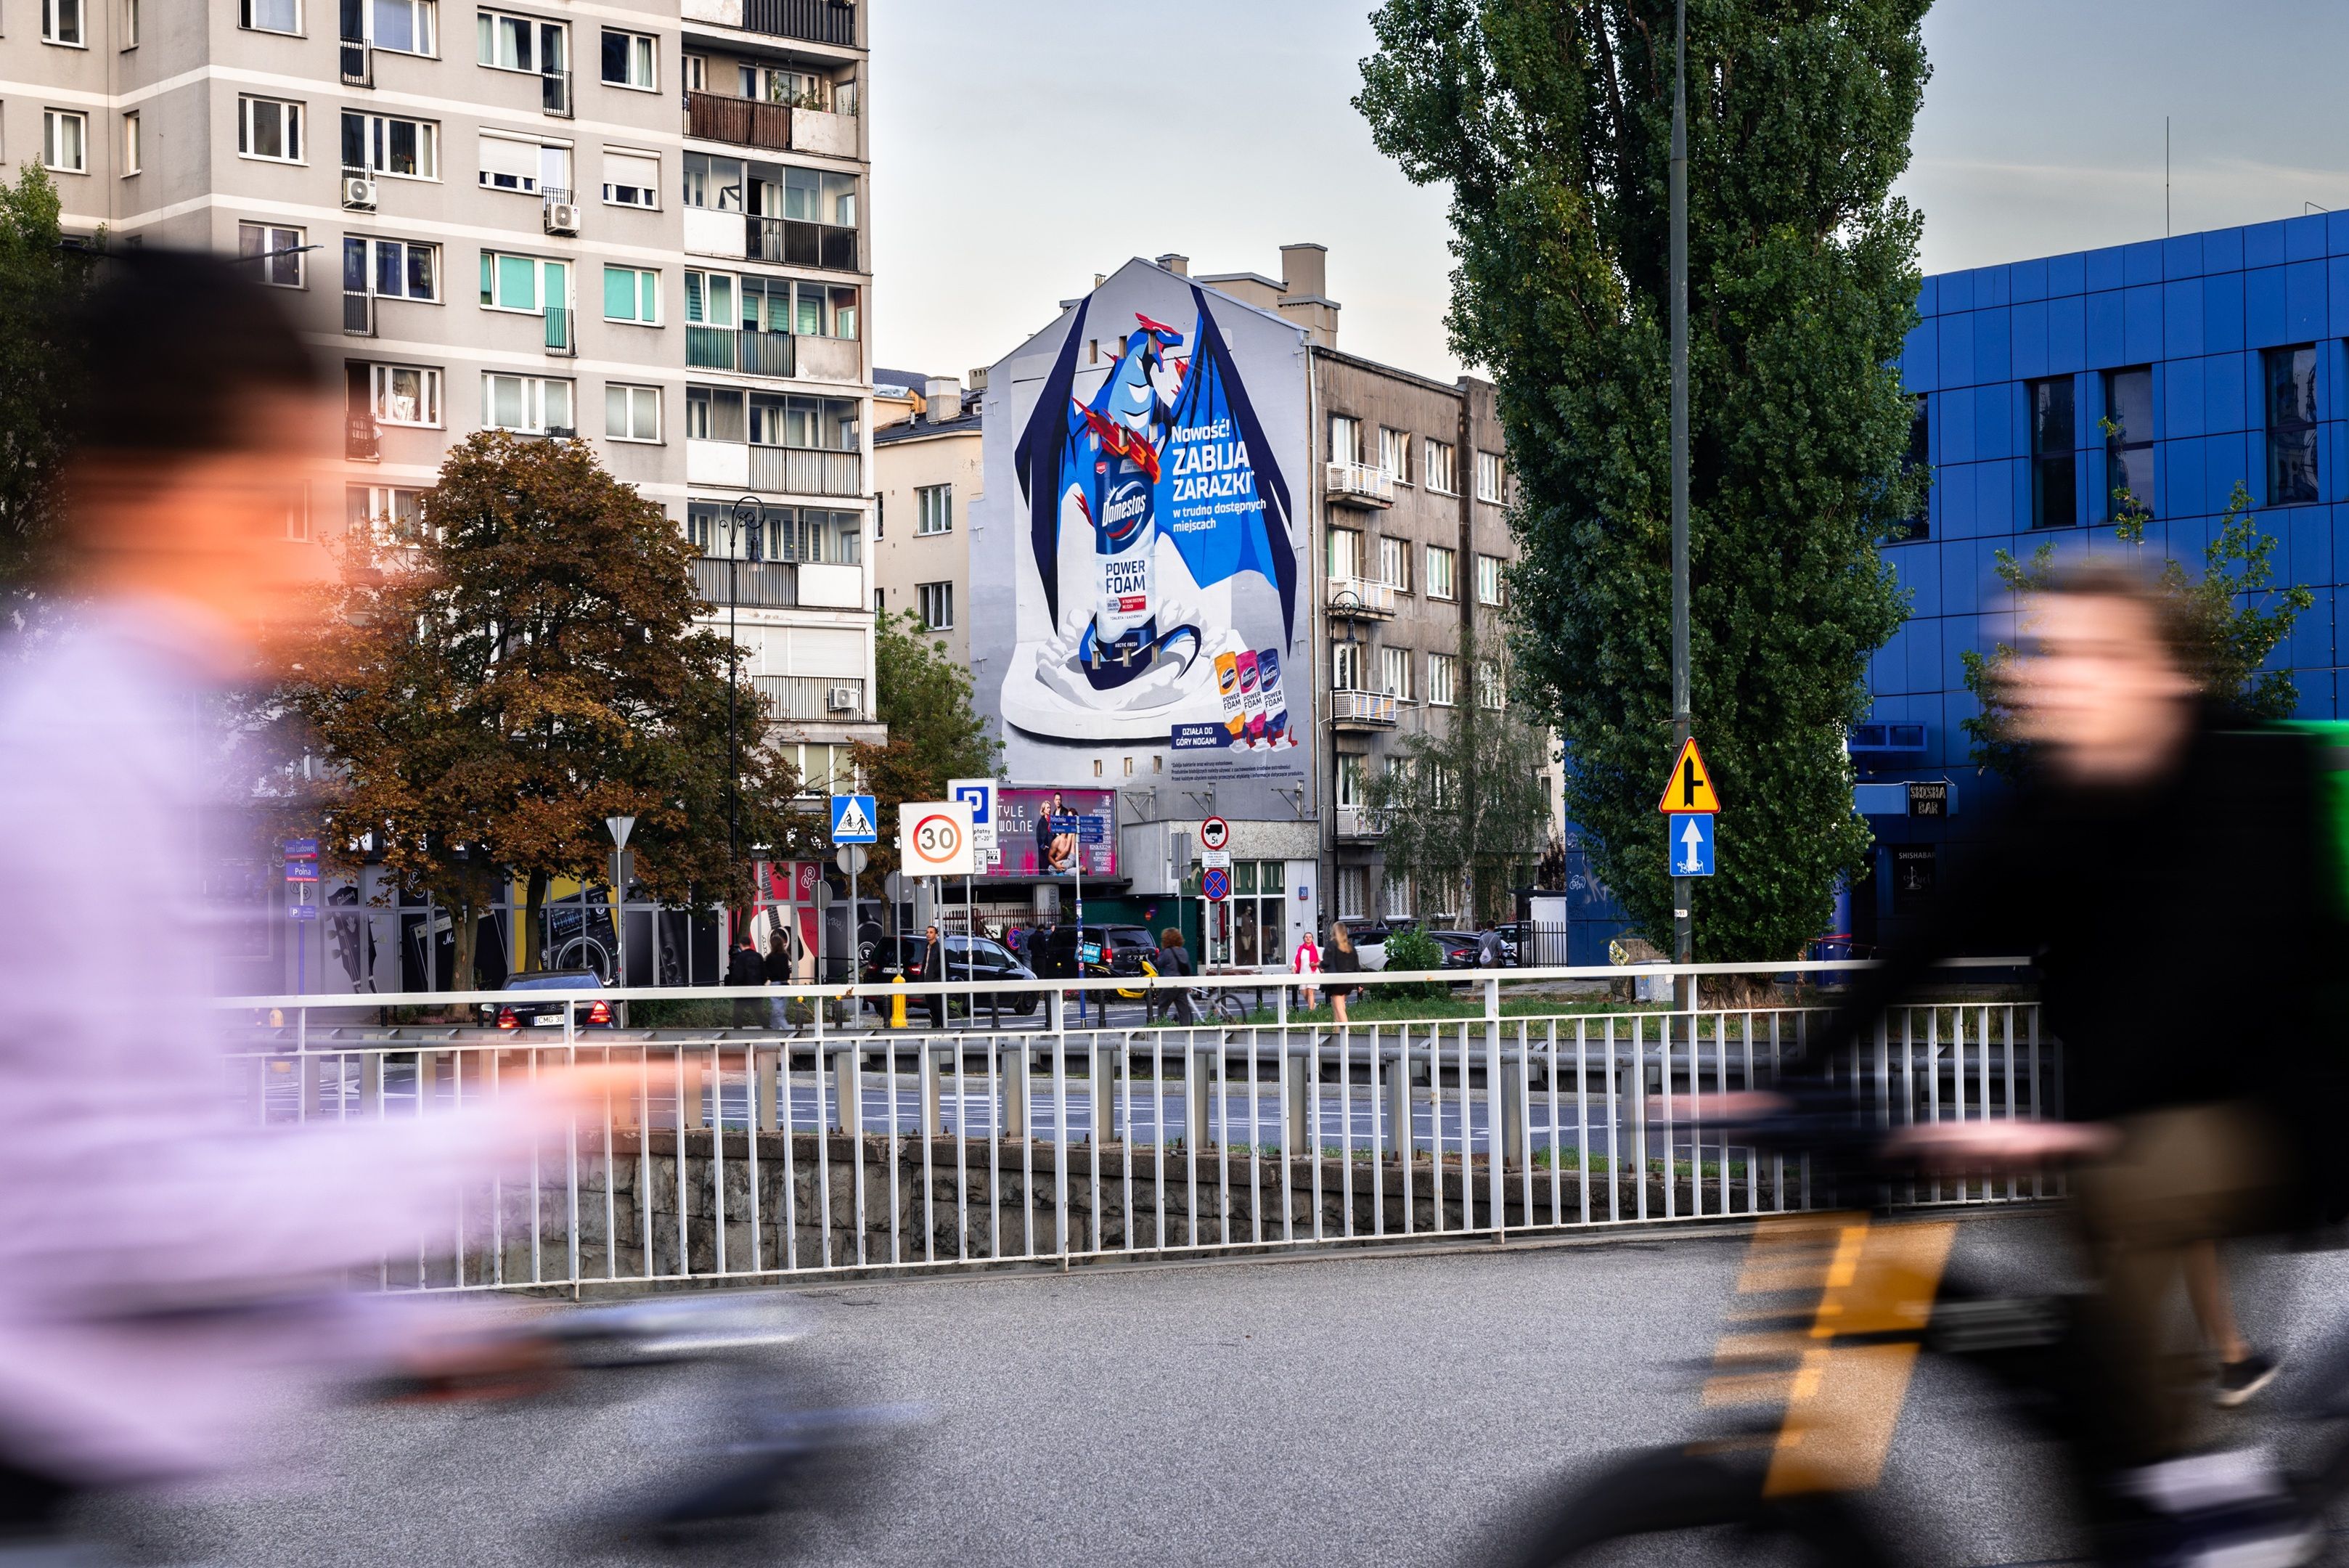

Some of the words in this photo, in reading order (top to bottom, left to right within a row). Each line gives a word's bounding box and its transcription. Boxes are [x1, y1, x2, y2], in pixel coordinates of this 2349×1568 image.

[1172, 418, 1230, 444] Nowość!
[1172, 441, 1250, 475] ZABIJA
[1102, 494, 1146, 527] Domestos
[1173, 510, 1180, 518] w
[1183, 505, 1212, 518] trudno
[1214, 499, 1266, 515] dostępnych
[1173, 518, 1217, 533] miejscach
[1106, 560, 1145, 576] POWER
[1106, 575, 1145, 594] FOAM
[1222, 693, 1240, 703] POWER
[1243, 691, 1262, 701] POWER
[1265, 690, 1282, 701] POWER
[1265, 696, 1283, 707] FOAM
[1224, 698, 1241, 710] FOAM
[1244, 697, 1262, 709] FOAM
[1182, 727, 1204, 736] DZIAŁA
[1176, 736, 1192, 746] GÓRY
[1193, 737, 1217, 746] NOGAMI
[1911, 785, 1945, 799] SHISHA
[997, 806, 1024, 817] TYLE
[1918, 801, 1938, 814] BAR
[999, 820, 1033, 832] WOLNE
[921, 828, 954, 849] 30
[296, 844, 315, 853] Ludowej
[337, 891, 356, 905] Gibson
